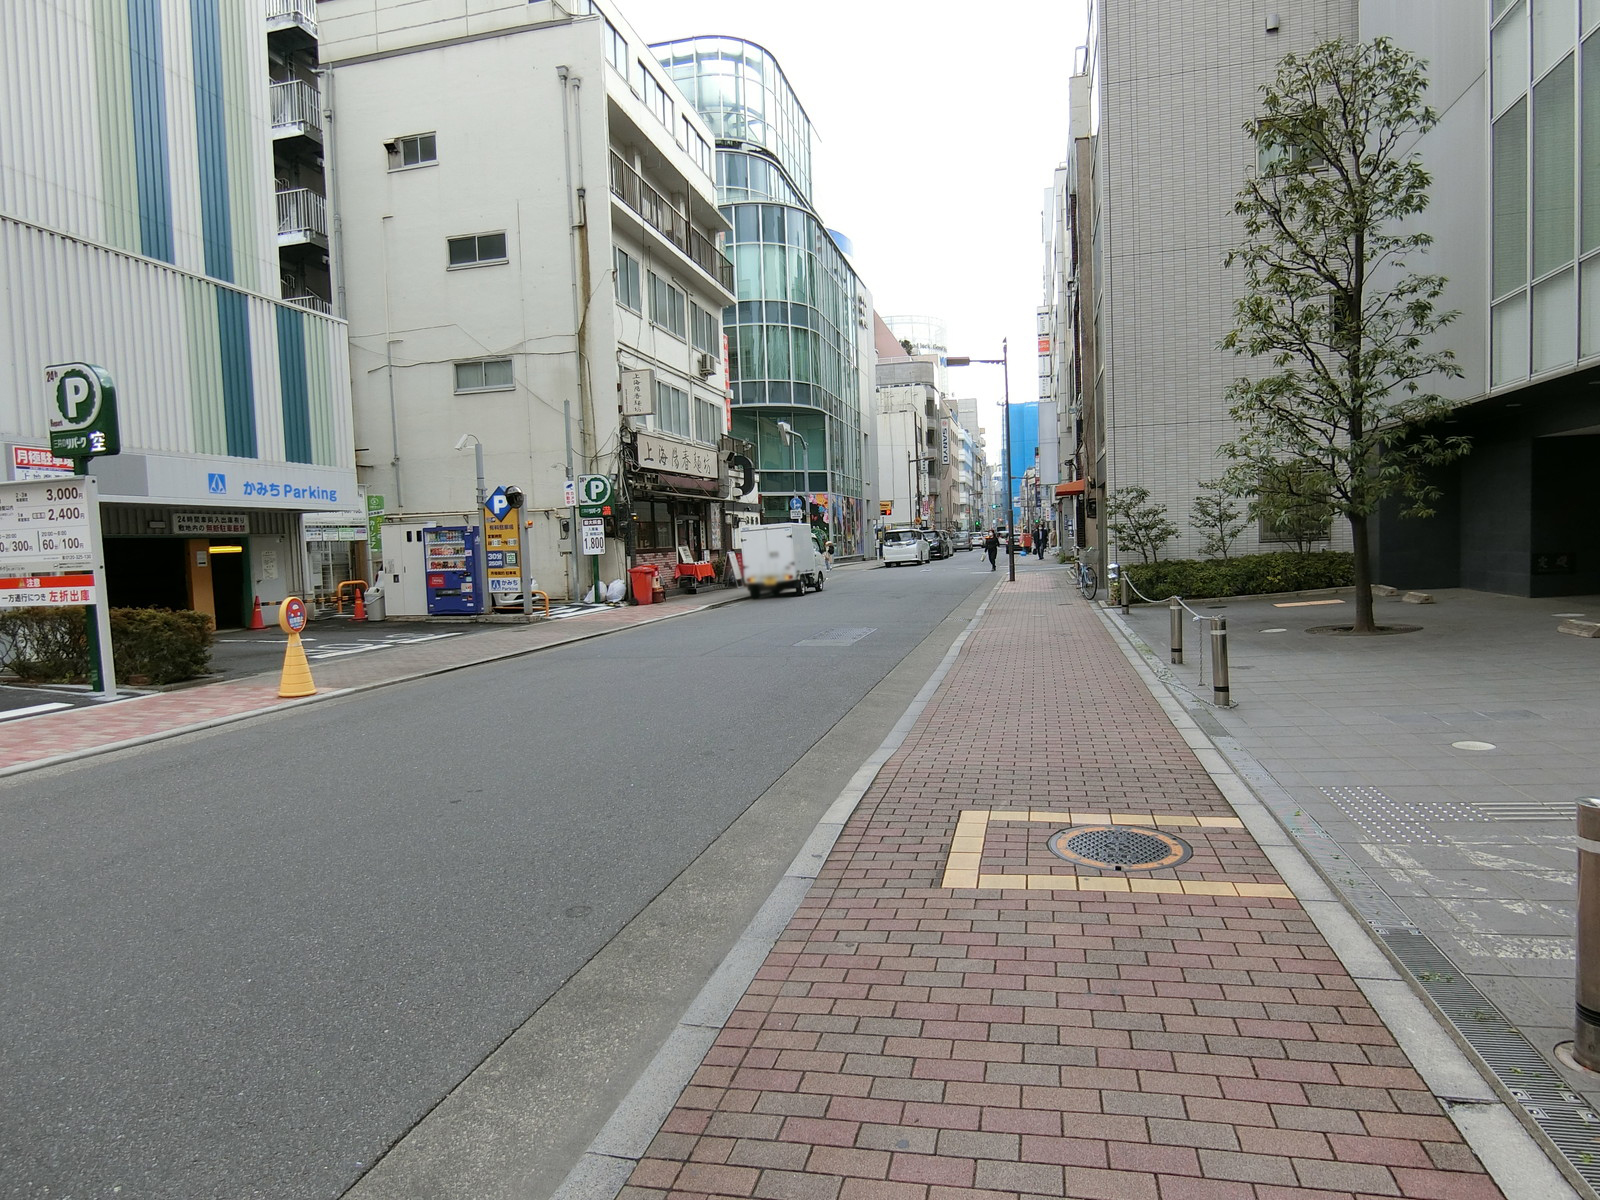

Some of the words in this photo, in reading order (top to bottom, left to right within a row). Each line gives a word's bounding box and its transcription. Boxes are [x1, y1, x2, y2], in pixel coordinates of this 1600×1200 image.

[65, 377, 89, 418] P
[89, 431, 107, 452] 空
[243, 481, 280, 497] かみち
[283, 484, 337, 502] Parking
[590, 480, 605, 500] P
[493, 495, 507, 514] P
[584, 537, 604, 550] 1,800
[26, 578, 41, 588] 注意
[2, 593, 46, 603] 一方通行につき
[49, 589, 90, 603] 左折出庫
